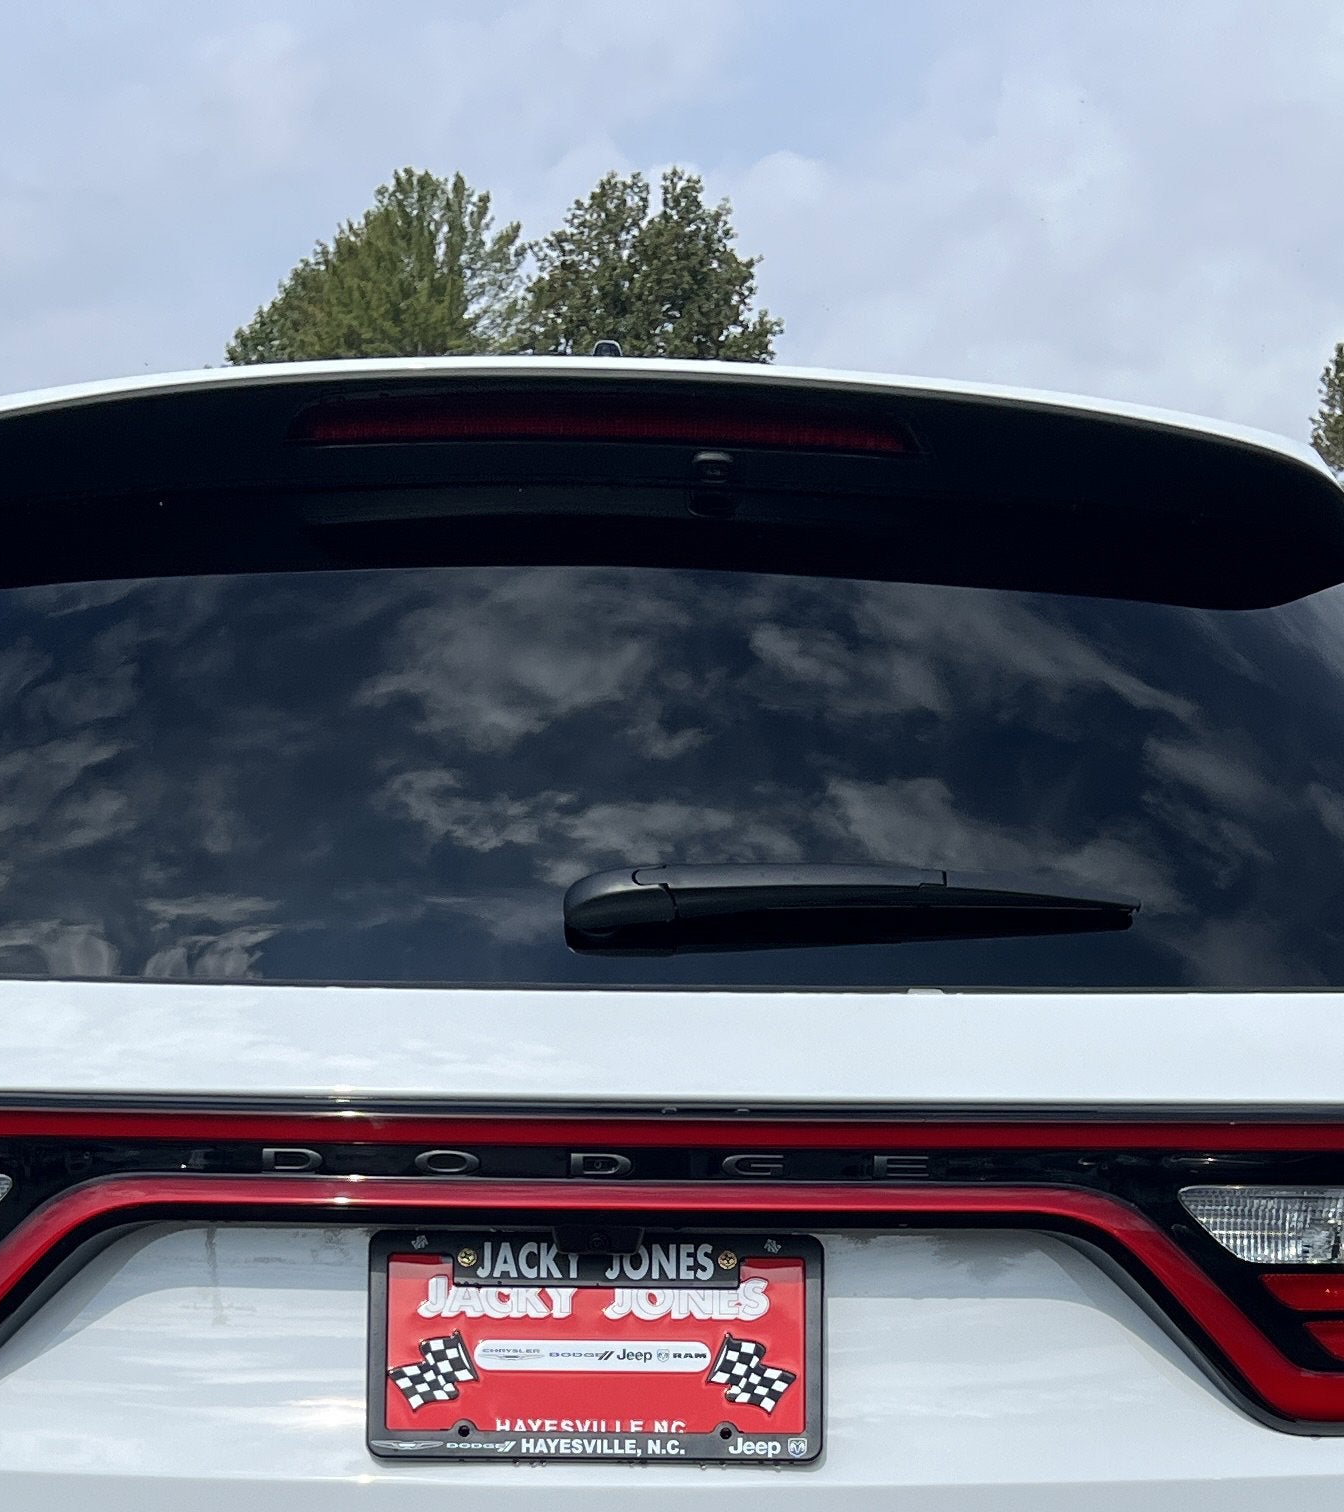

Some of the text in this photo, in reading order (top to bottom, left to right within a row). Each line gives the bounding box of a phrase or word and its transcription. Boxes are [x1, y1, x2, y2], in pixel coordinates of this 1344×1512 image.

[262, 1148, 929, 1177] DODGE
[476, 1241, 715, 1281] JACKY JONES
[417, 1276, 770, 1321] JACKY JONES
[617, 1349, 652, 1363] Jeep
[521, 1438, 641, 1457] HAYESVILLE,
[647, 1439, 685, 1455] N.C.
[728, 1438, 781, 1458] Jeep
